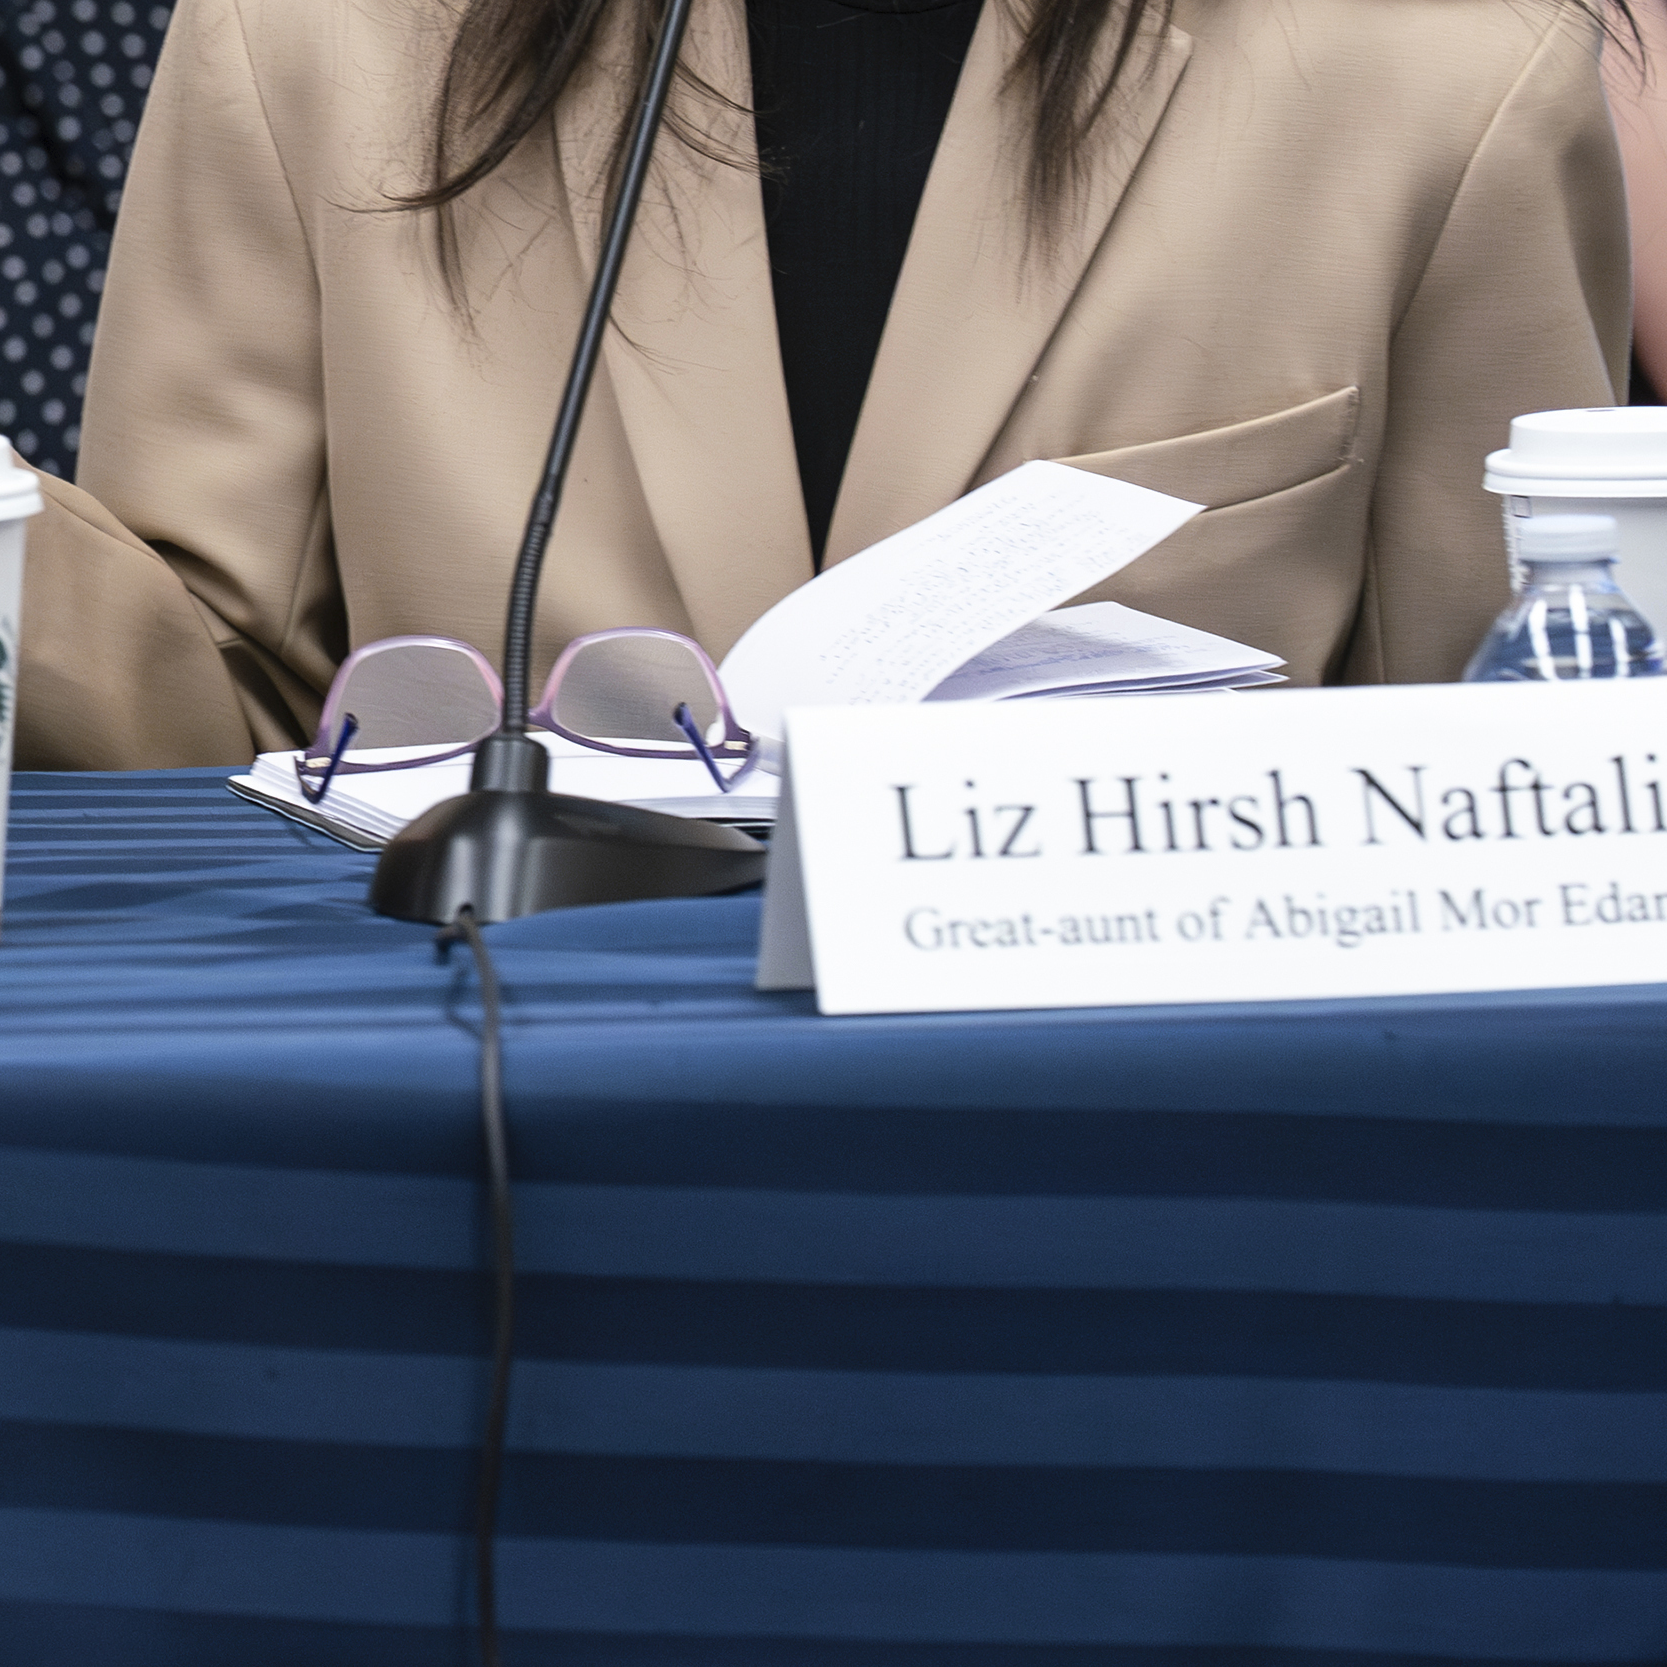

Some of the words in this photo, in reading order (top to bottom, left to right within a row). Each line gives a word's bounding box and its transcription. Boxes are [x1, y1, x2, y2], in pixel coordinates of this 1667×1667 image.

[891, 779, 1042, 862] Liz
[1072, 768, 1324, 856] Hirsh
[1350, 752, 1667, 845] Naftali
[903, 907, 1160, 951] Great-aunt
[1176, 897, 1231, 941] of
[1245, 889, 1422, 949] Abigail
[1437, 888, 1542, 931] Mor
